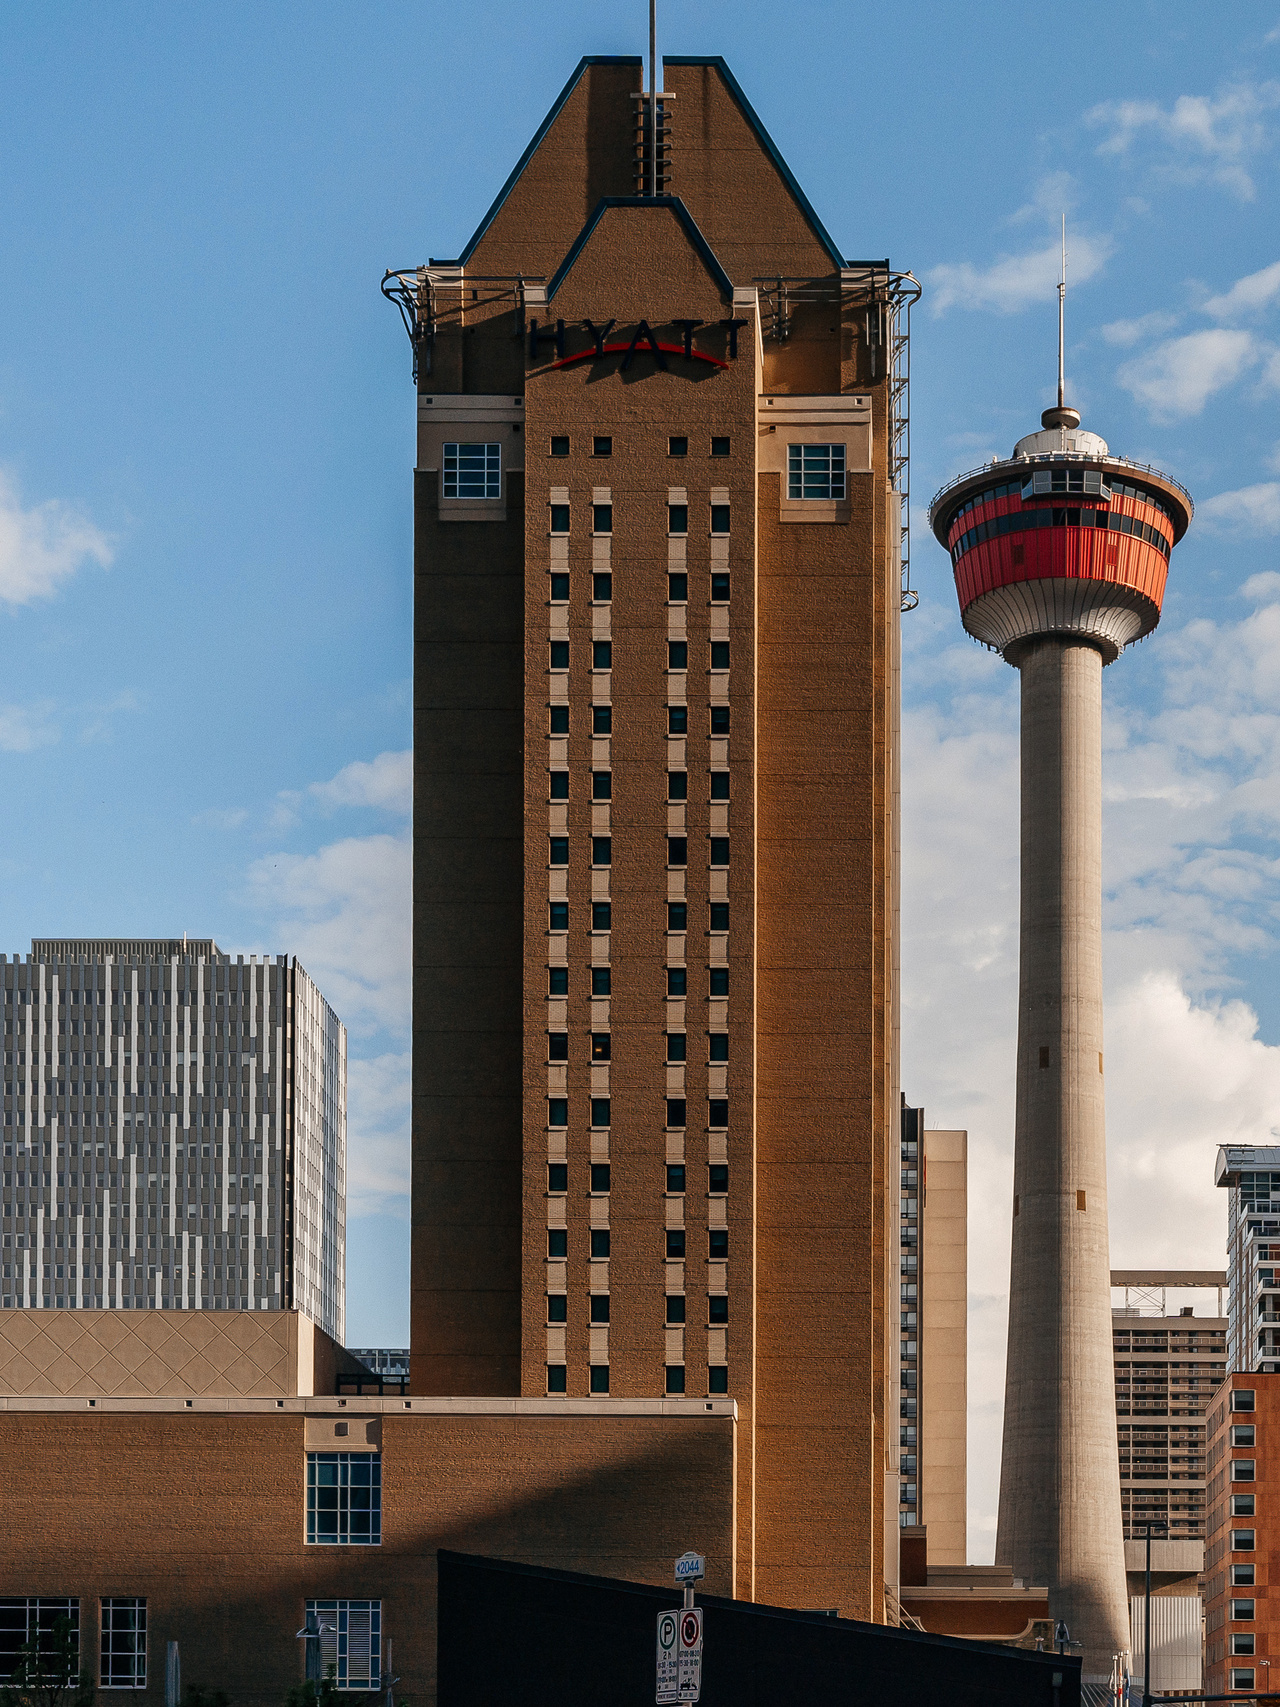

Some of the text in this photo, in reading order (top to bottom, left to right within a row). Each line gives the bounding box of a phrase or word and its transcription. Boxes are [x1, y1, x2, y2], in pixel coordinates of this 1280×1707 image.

[530, 319, 748, 370] HYATT
[680, 1560, 699, 1574] 2044
[663, 1622, 672, 1643] P
[663, 1651, 672, 1660] 2 h
